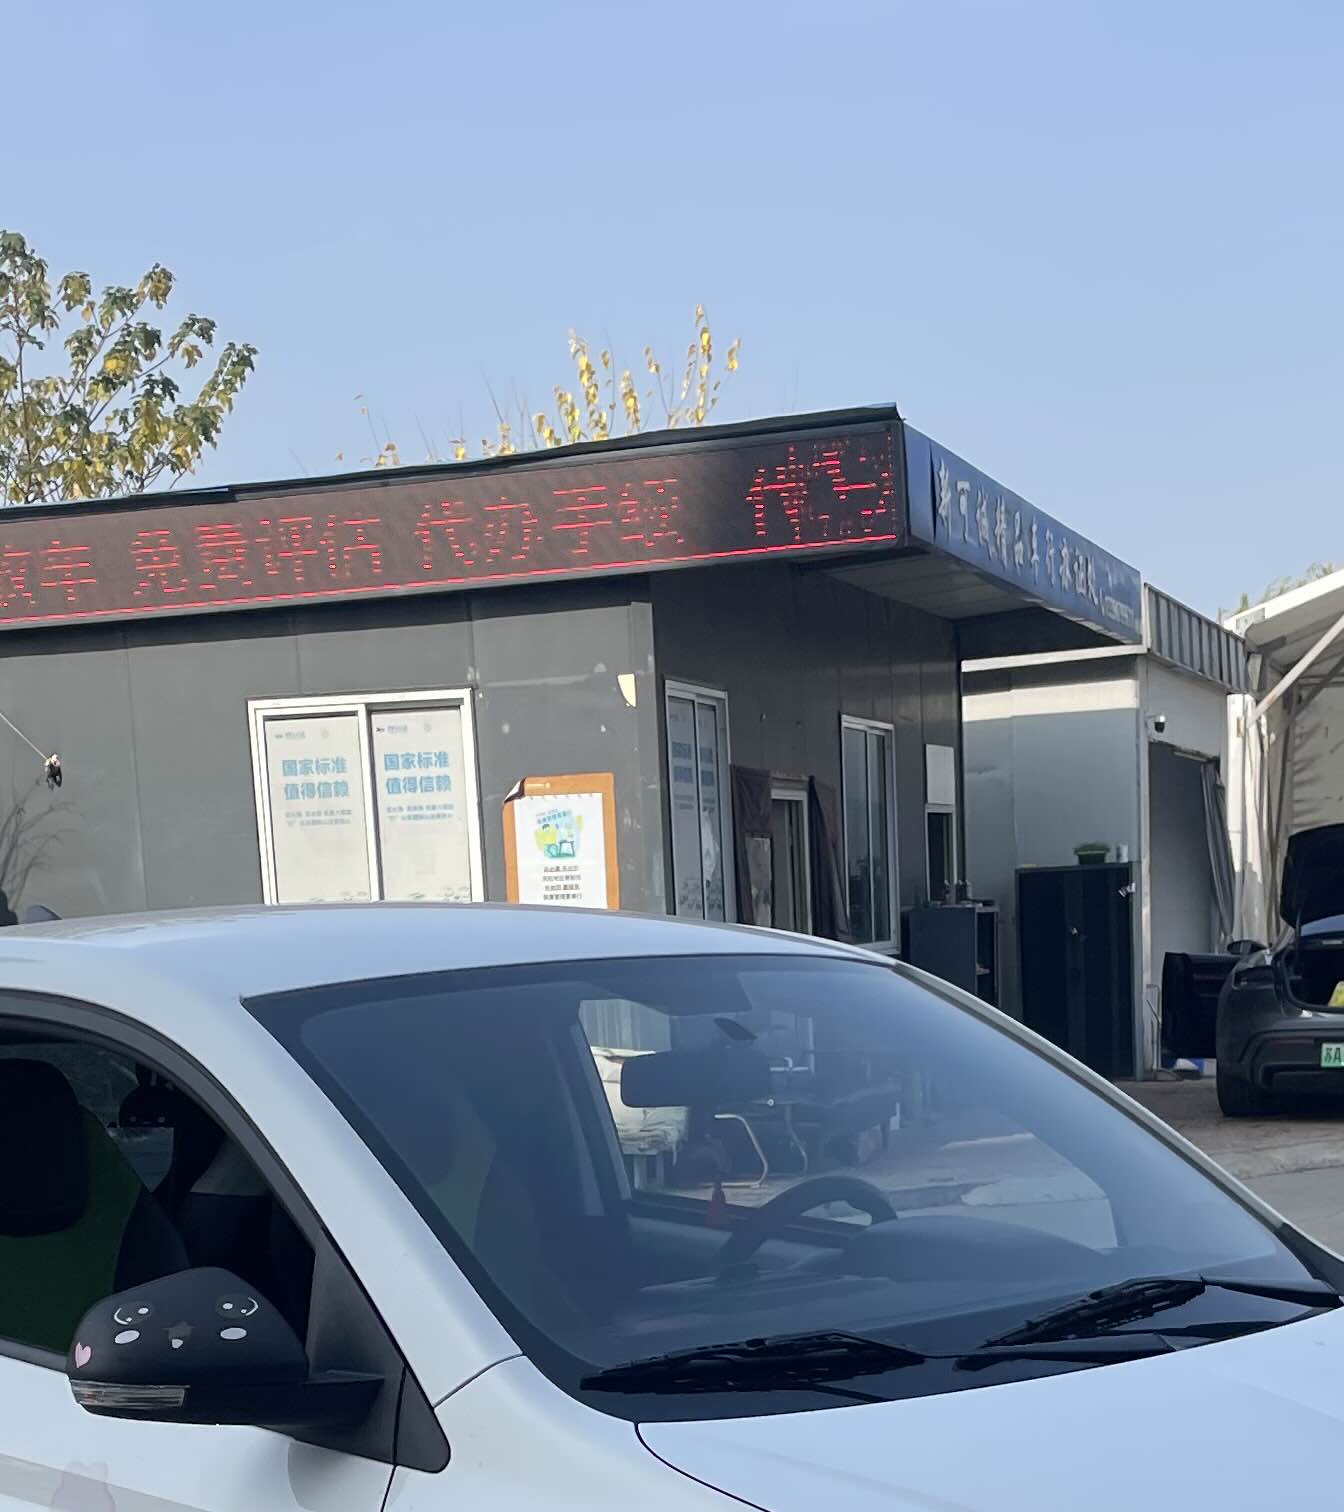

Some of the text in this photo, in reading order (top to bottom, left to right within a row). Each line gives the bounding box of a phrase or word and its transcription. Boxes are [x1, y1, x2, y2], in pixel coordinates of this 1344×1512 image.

[282, 757, 348, 777] 国家标准
[383, 751, 449, 771] 国家标准
[284, 780, 349, 800] 值得信赖
[386, 776, 452, 795] 值得信赖
